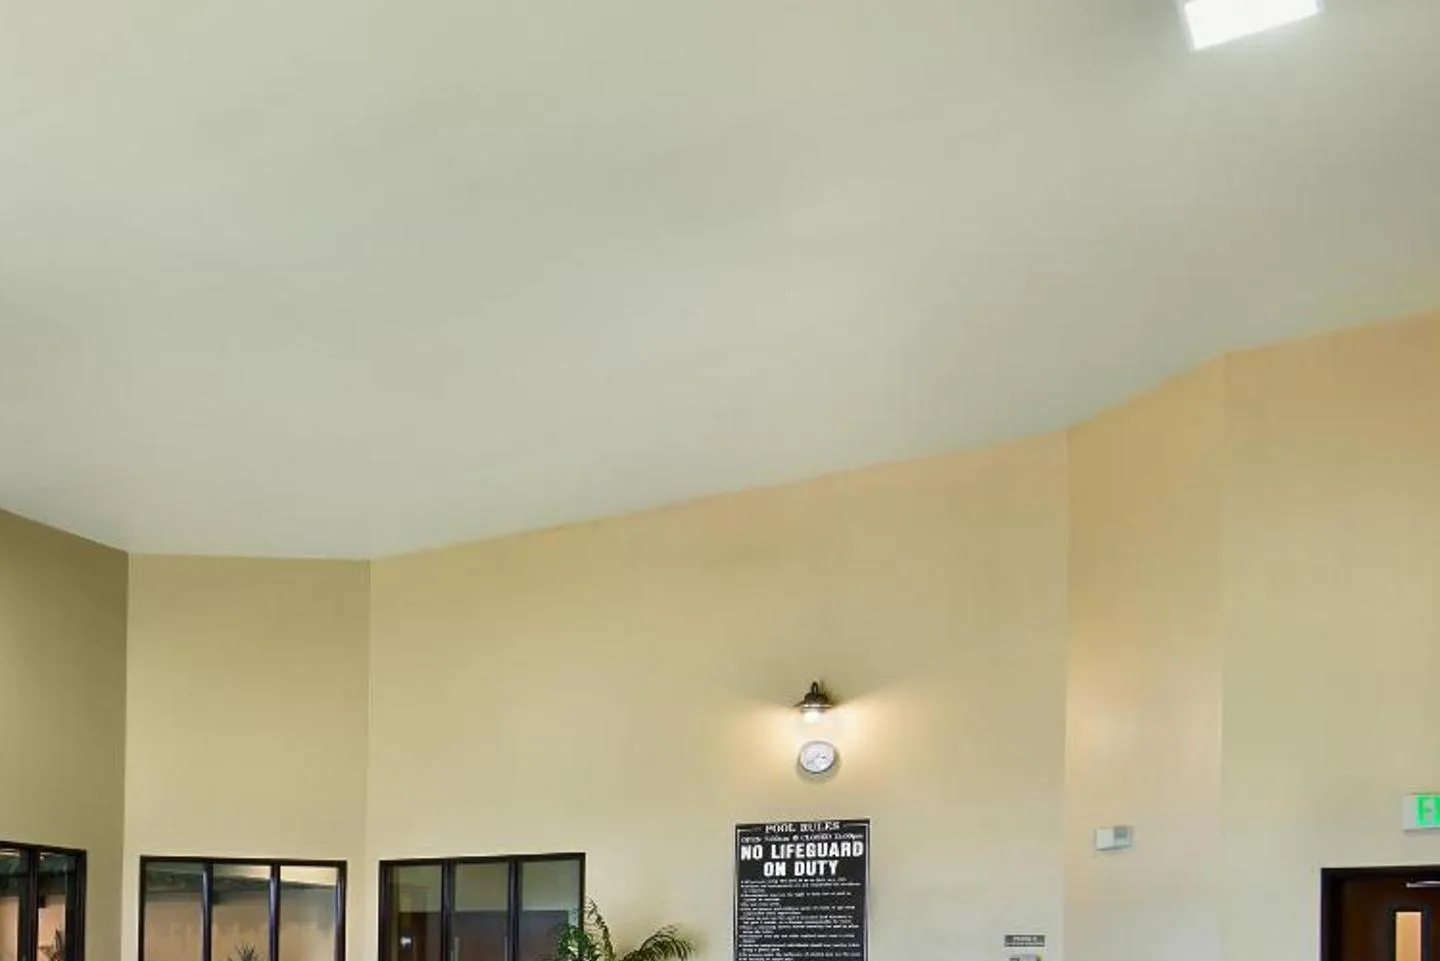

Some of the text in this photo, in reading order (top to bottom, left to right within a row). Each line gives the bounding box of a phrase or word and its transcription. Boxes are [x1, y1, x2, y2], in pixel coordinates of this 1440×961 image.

[765, 821, 840, 834] POOL RULES
[740, 841, 864, 860] NO LIFEGUARD
[763, 860, 839, 877] ON DUTY
